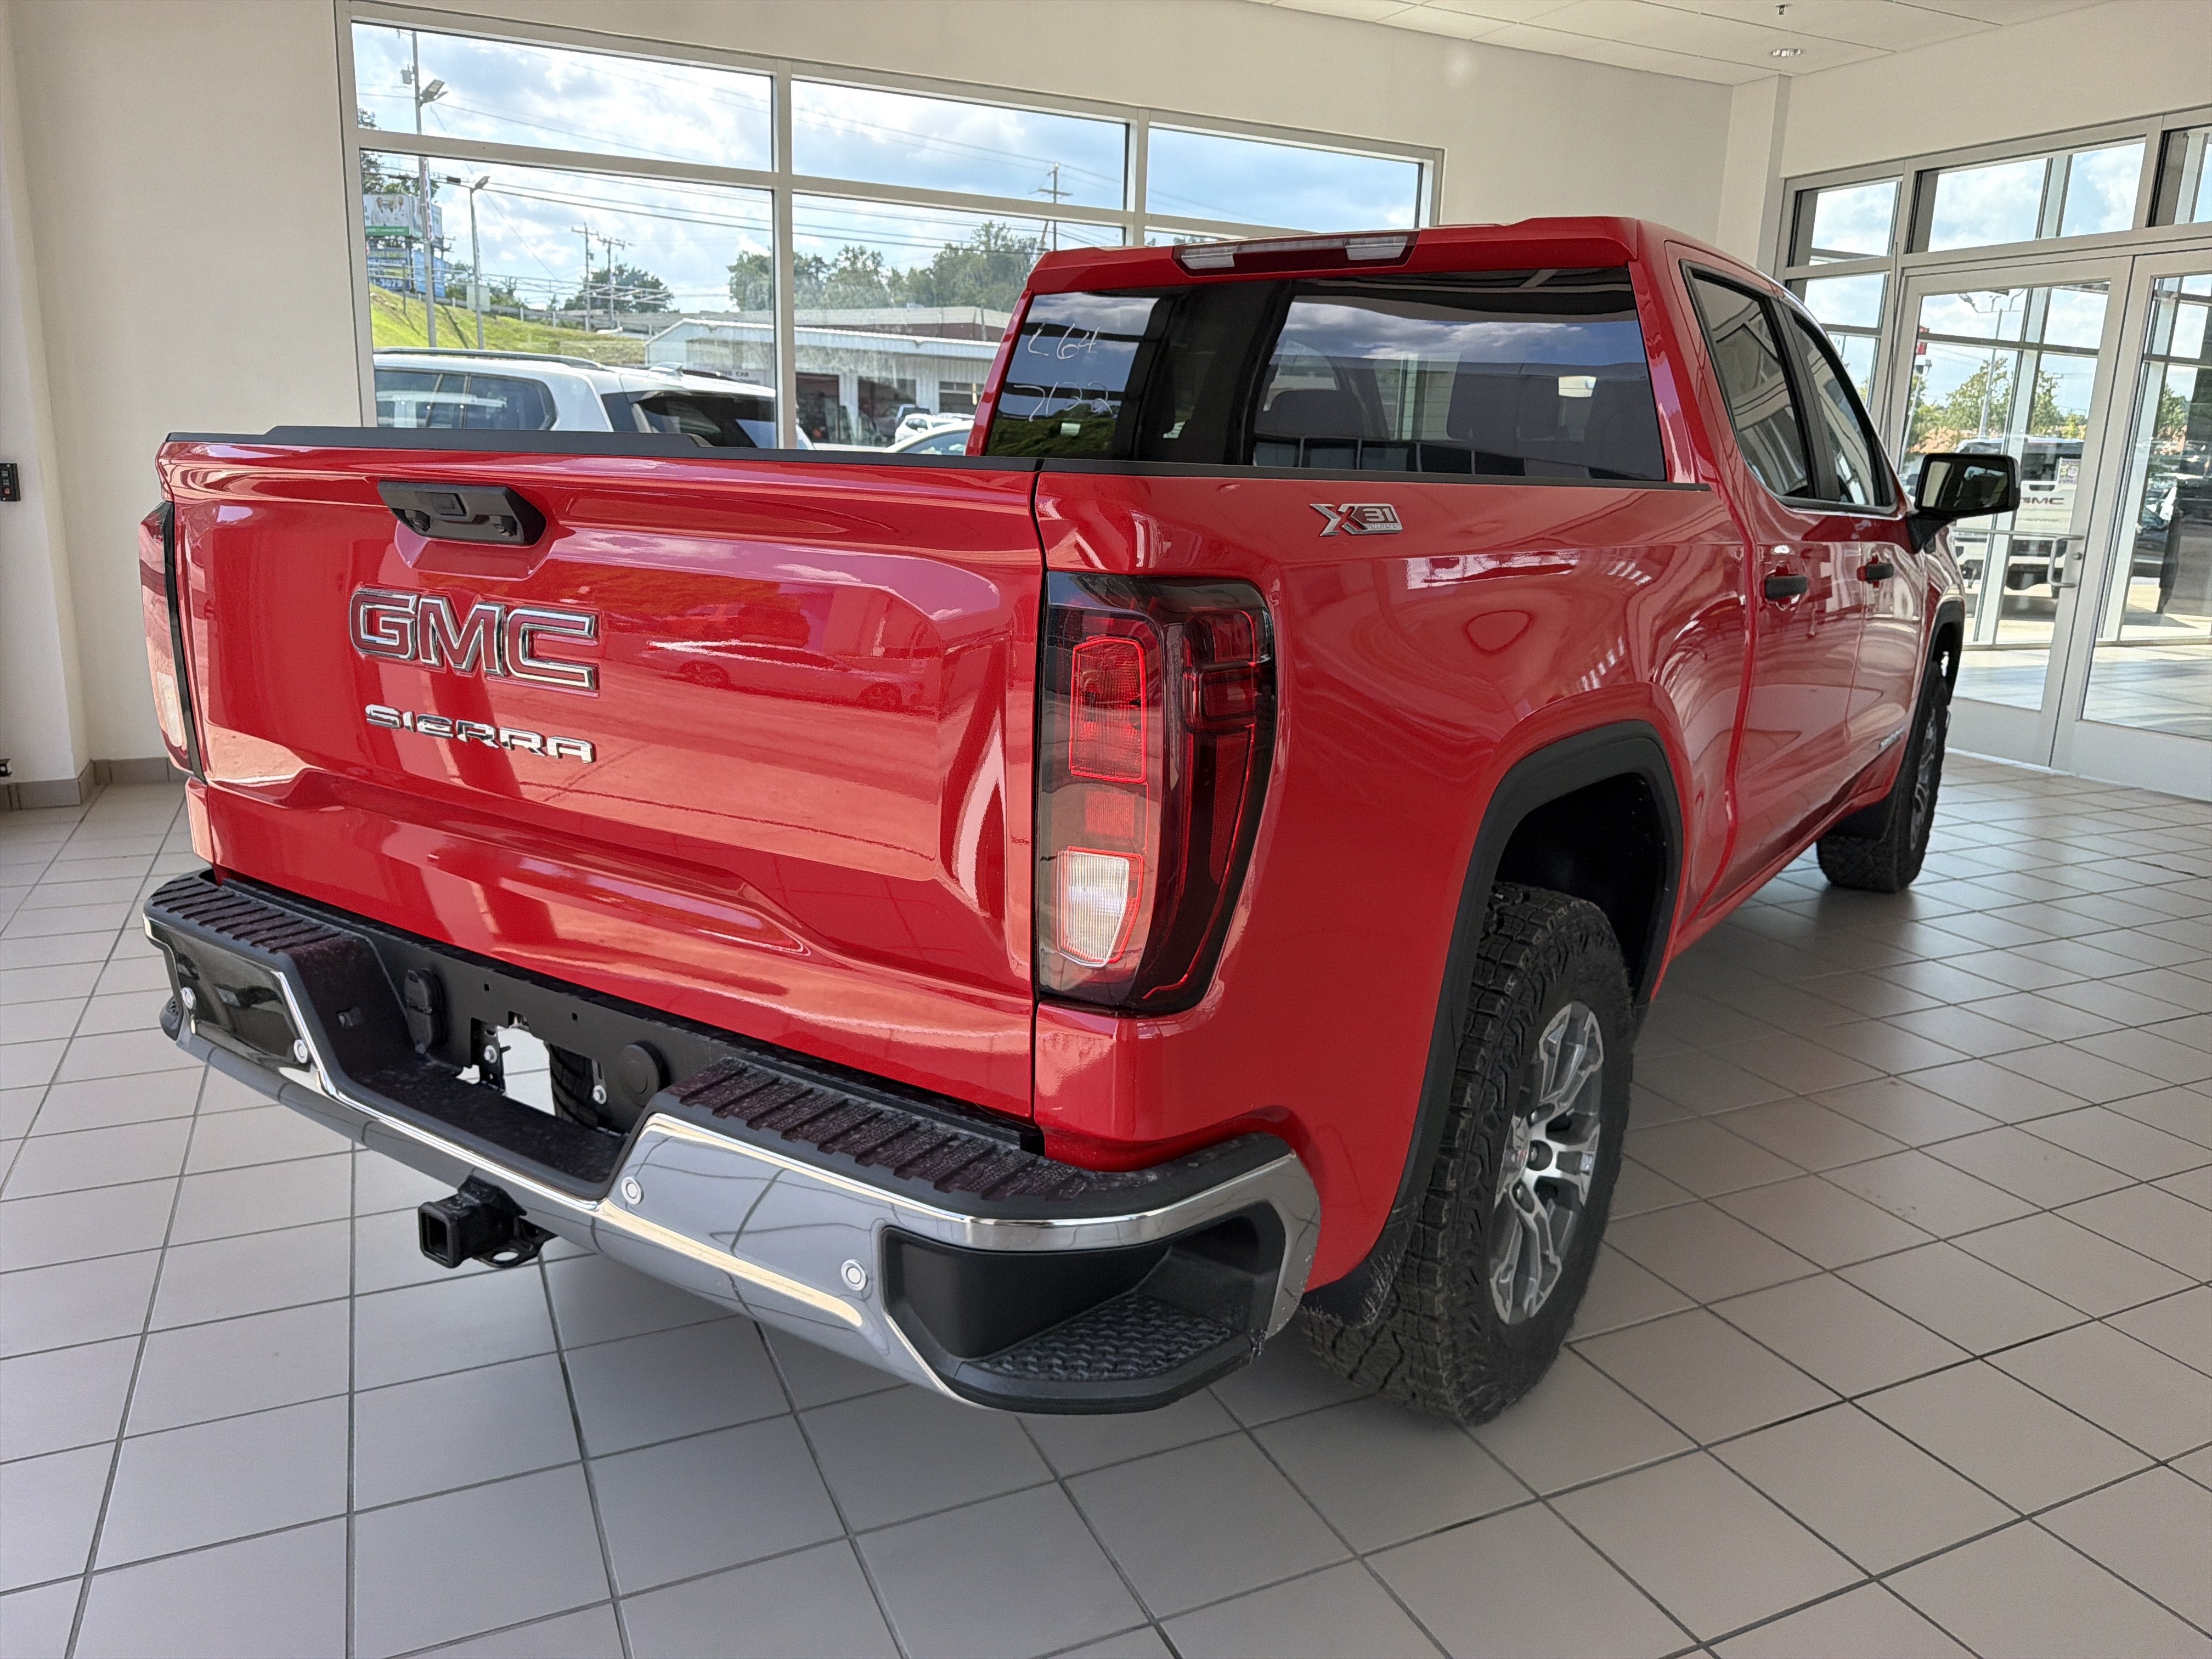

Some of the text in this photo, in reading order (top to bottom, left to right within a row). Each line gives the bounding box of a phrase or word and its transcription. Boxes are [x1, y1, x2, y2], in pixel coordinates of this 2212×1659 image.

[1309, 503, 1403, 537] X31
[349, 588, 599, 690] GMC
[365, 704, 597, 764] SIERRA
